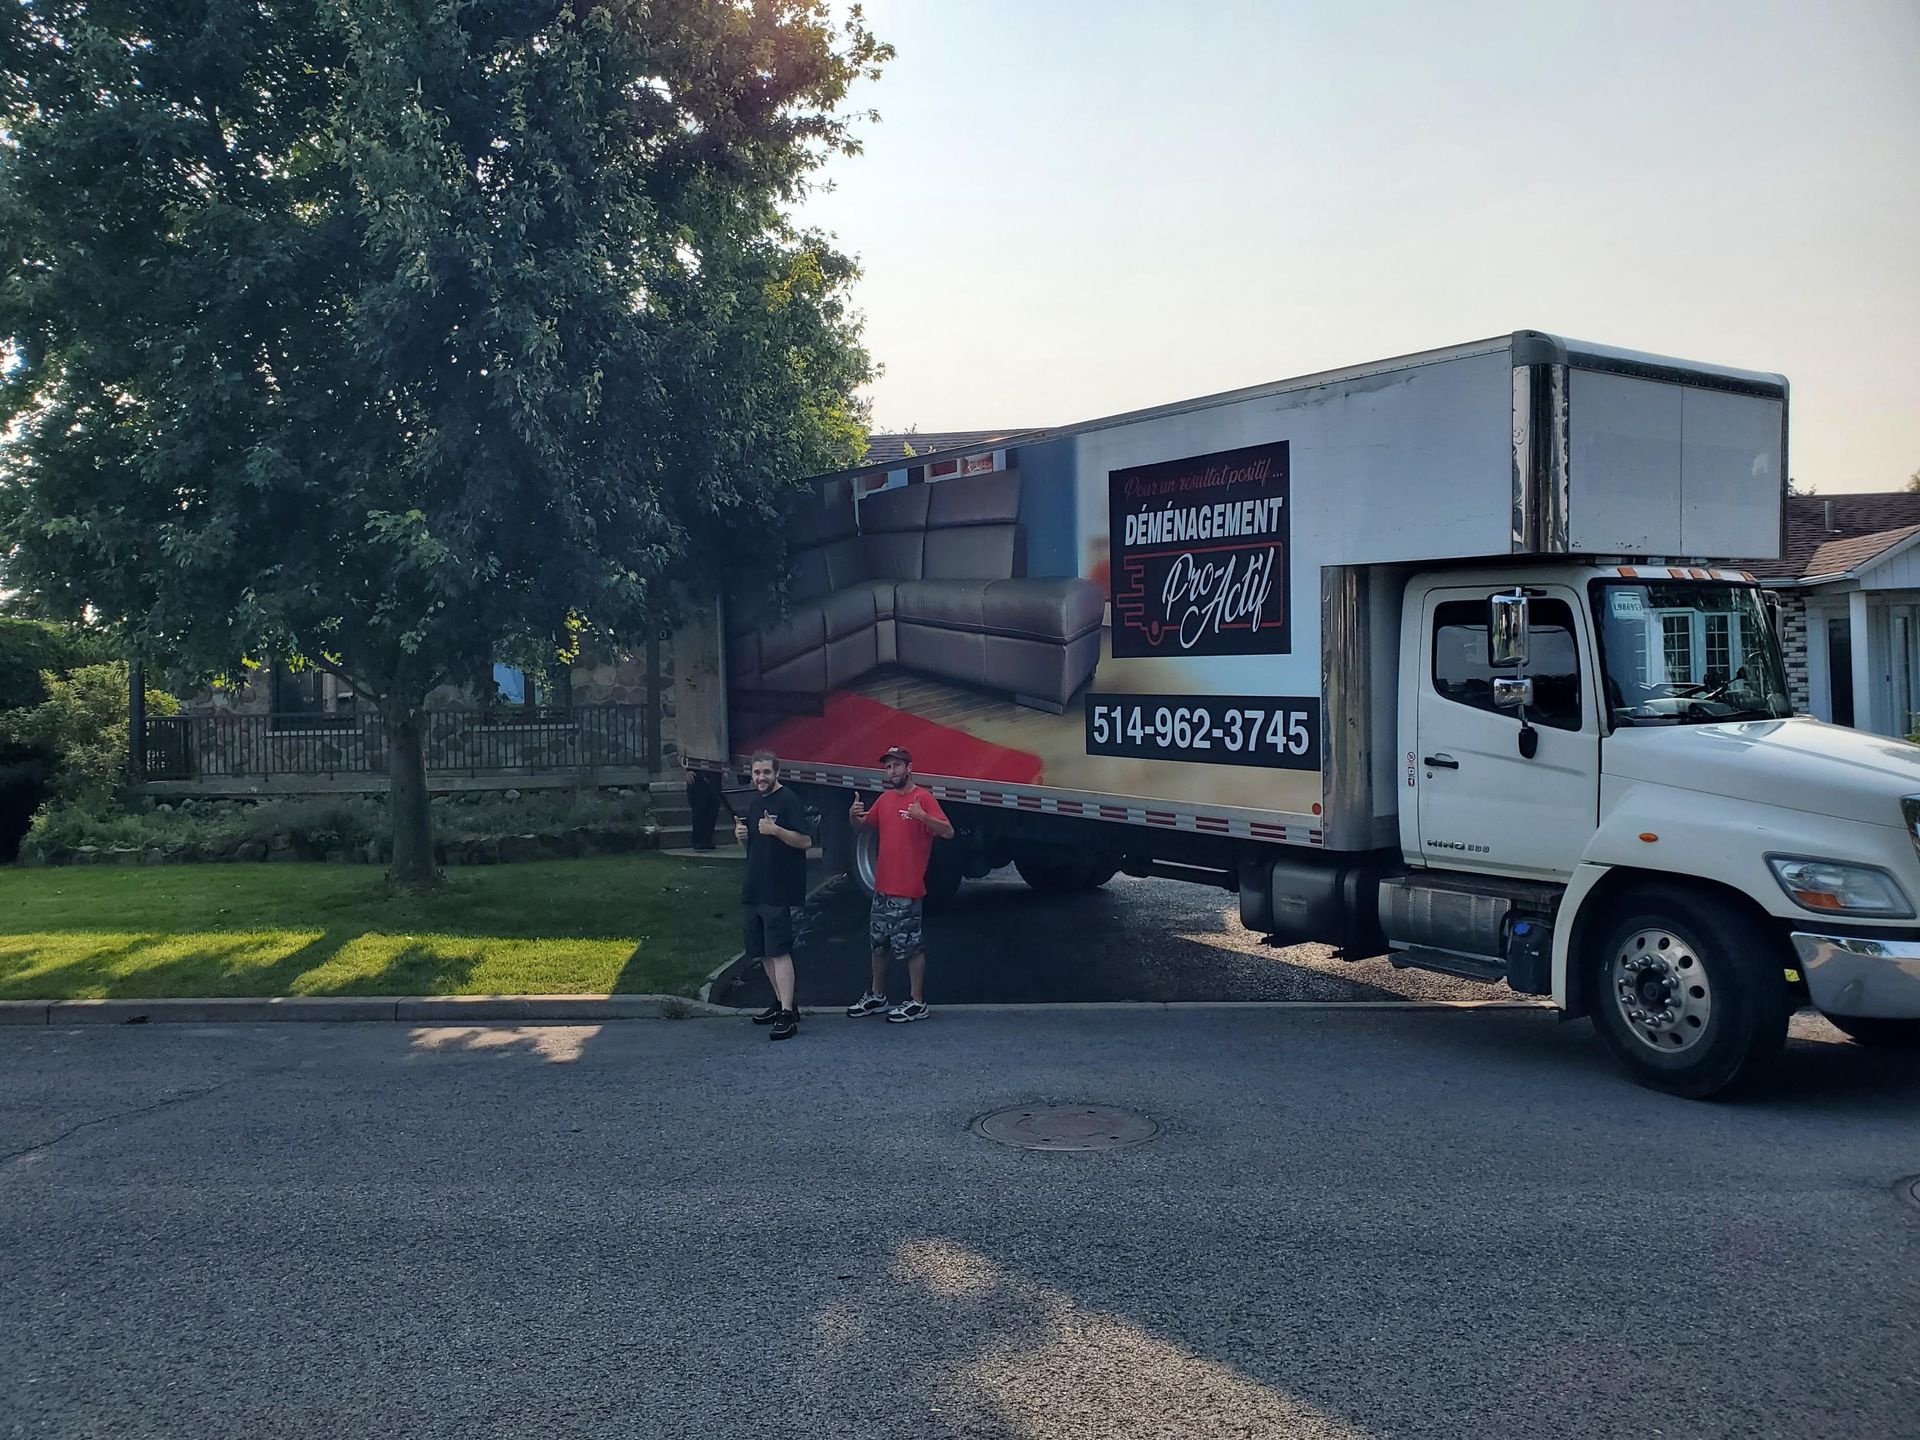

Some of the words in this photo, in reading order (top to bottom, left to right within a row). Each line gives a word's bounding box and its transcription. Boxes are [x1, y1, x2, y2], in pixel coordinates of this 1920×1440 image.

[1124, 475, 1161, 500] Pour
[1159, 480, 1176, 495] un
[1124, 497, 1283, 546] DÉMÉNAGEMENT
[1093, 705, 1310, 756] 514-962-3745
